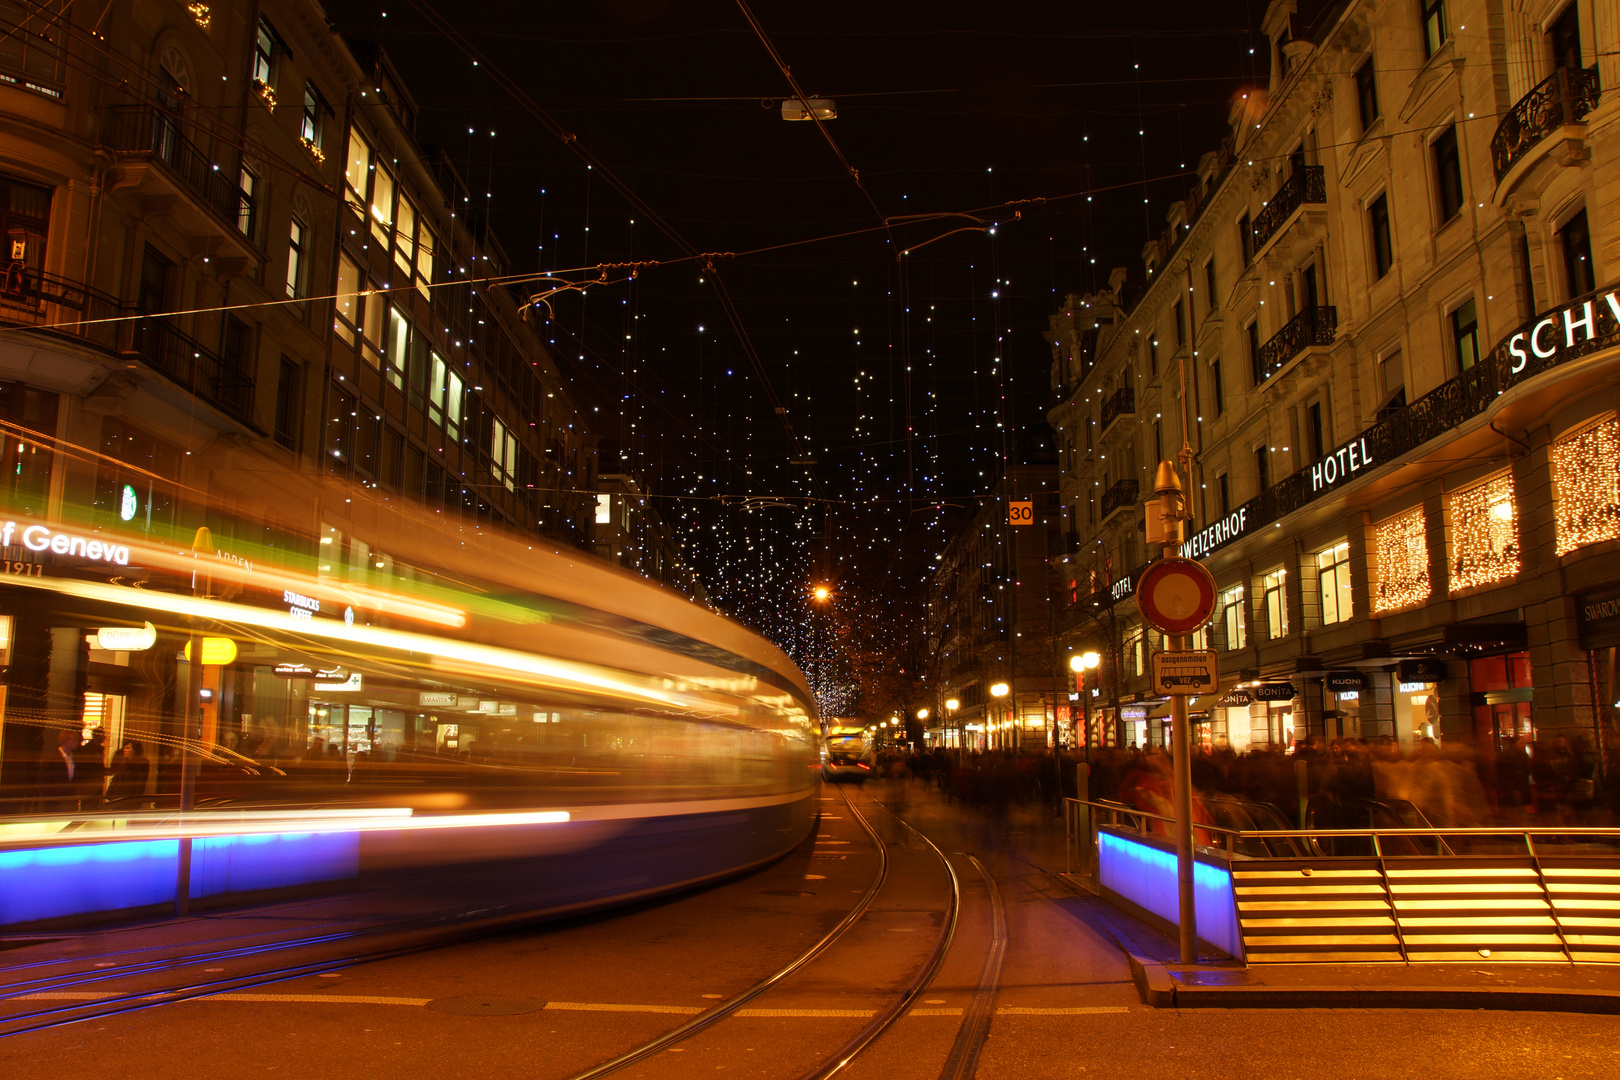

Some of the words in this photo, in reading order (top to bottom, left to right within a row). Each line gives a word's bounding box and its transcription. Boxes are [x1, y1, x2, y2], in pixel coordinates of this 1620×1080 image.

[1312, 437, 1373, 492] HOTEL
[1010, 506, 1032, 520] 30
[1178, 507, 1247, 559] WEIZERHOF
[0, 521, 16, 547] f
[23, 525, 130, 565] Geneva
[4, 560, 43, 578] 1911
[283, 590, 320, 612] STARBUCKS
[290, 606, 313, 621] COFFEE
[1161, 655, 1208, 665] ausgenommen
[1179, 676, 1192, 684] VBZ
[1332, 678, 1361, 686] KUONI
[1399, 682, 1425, 693] KUONI
